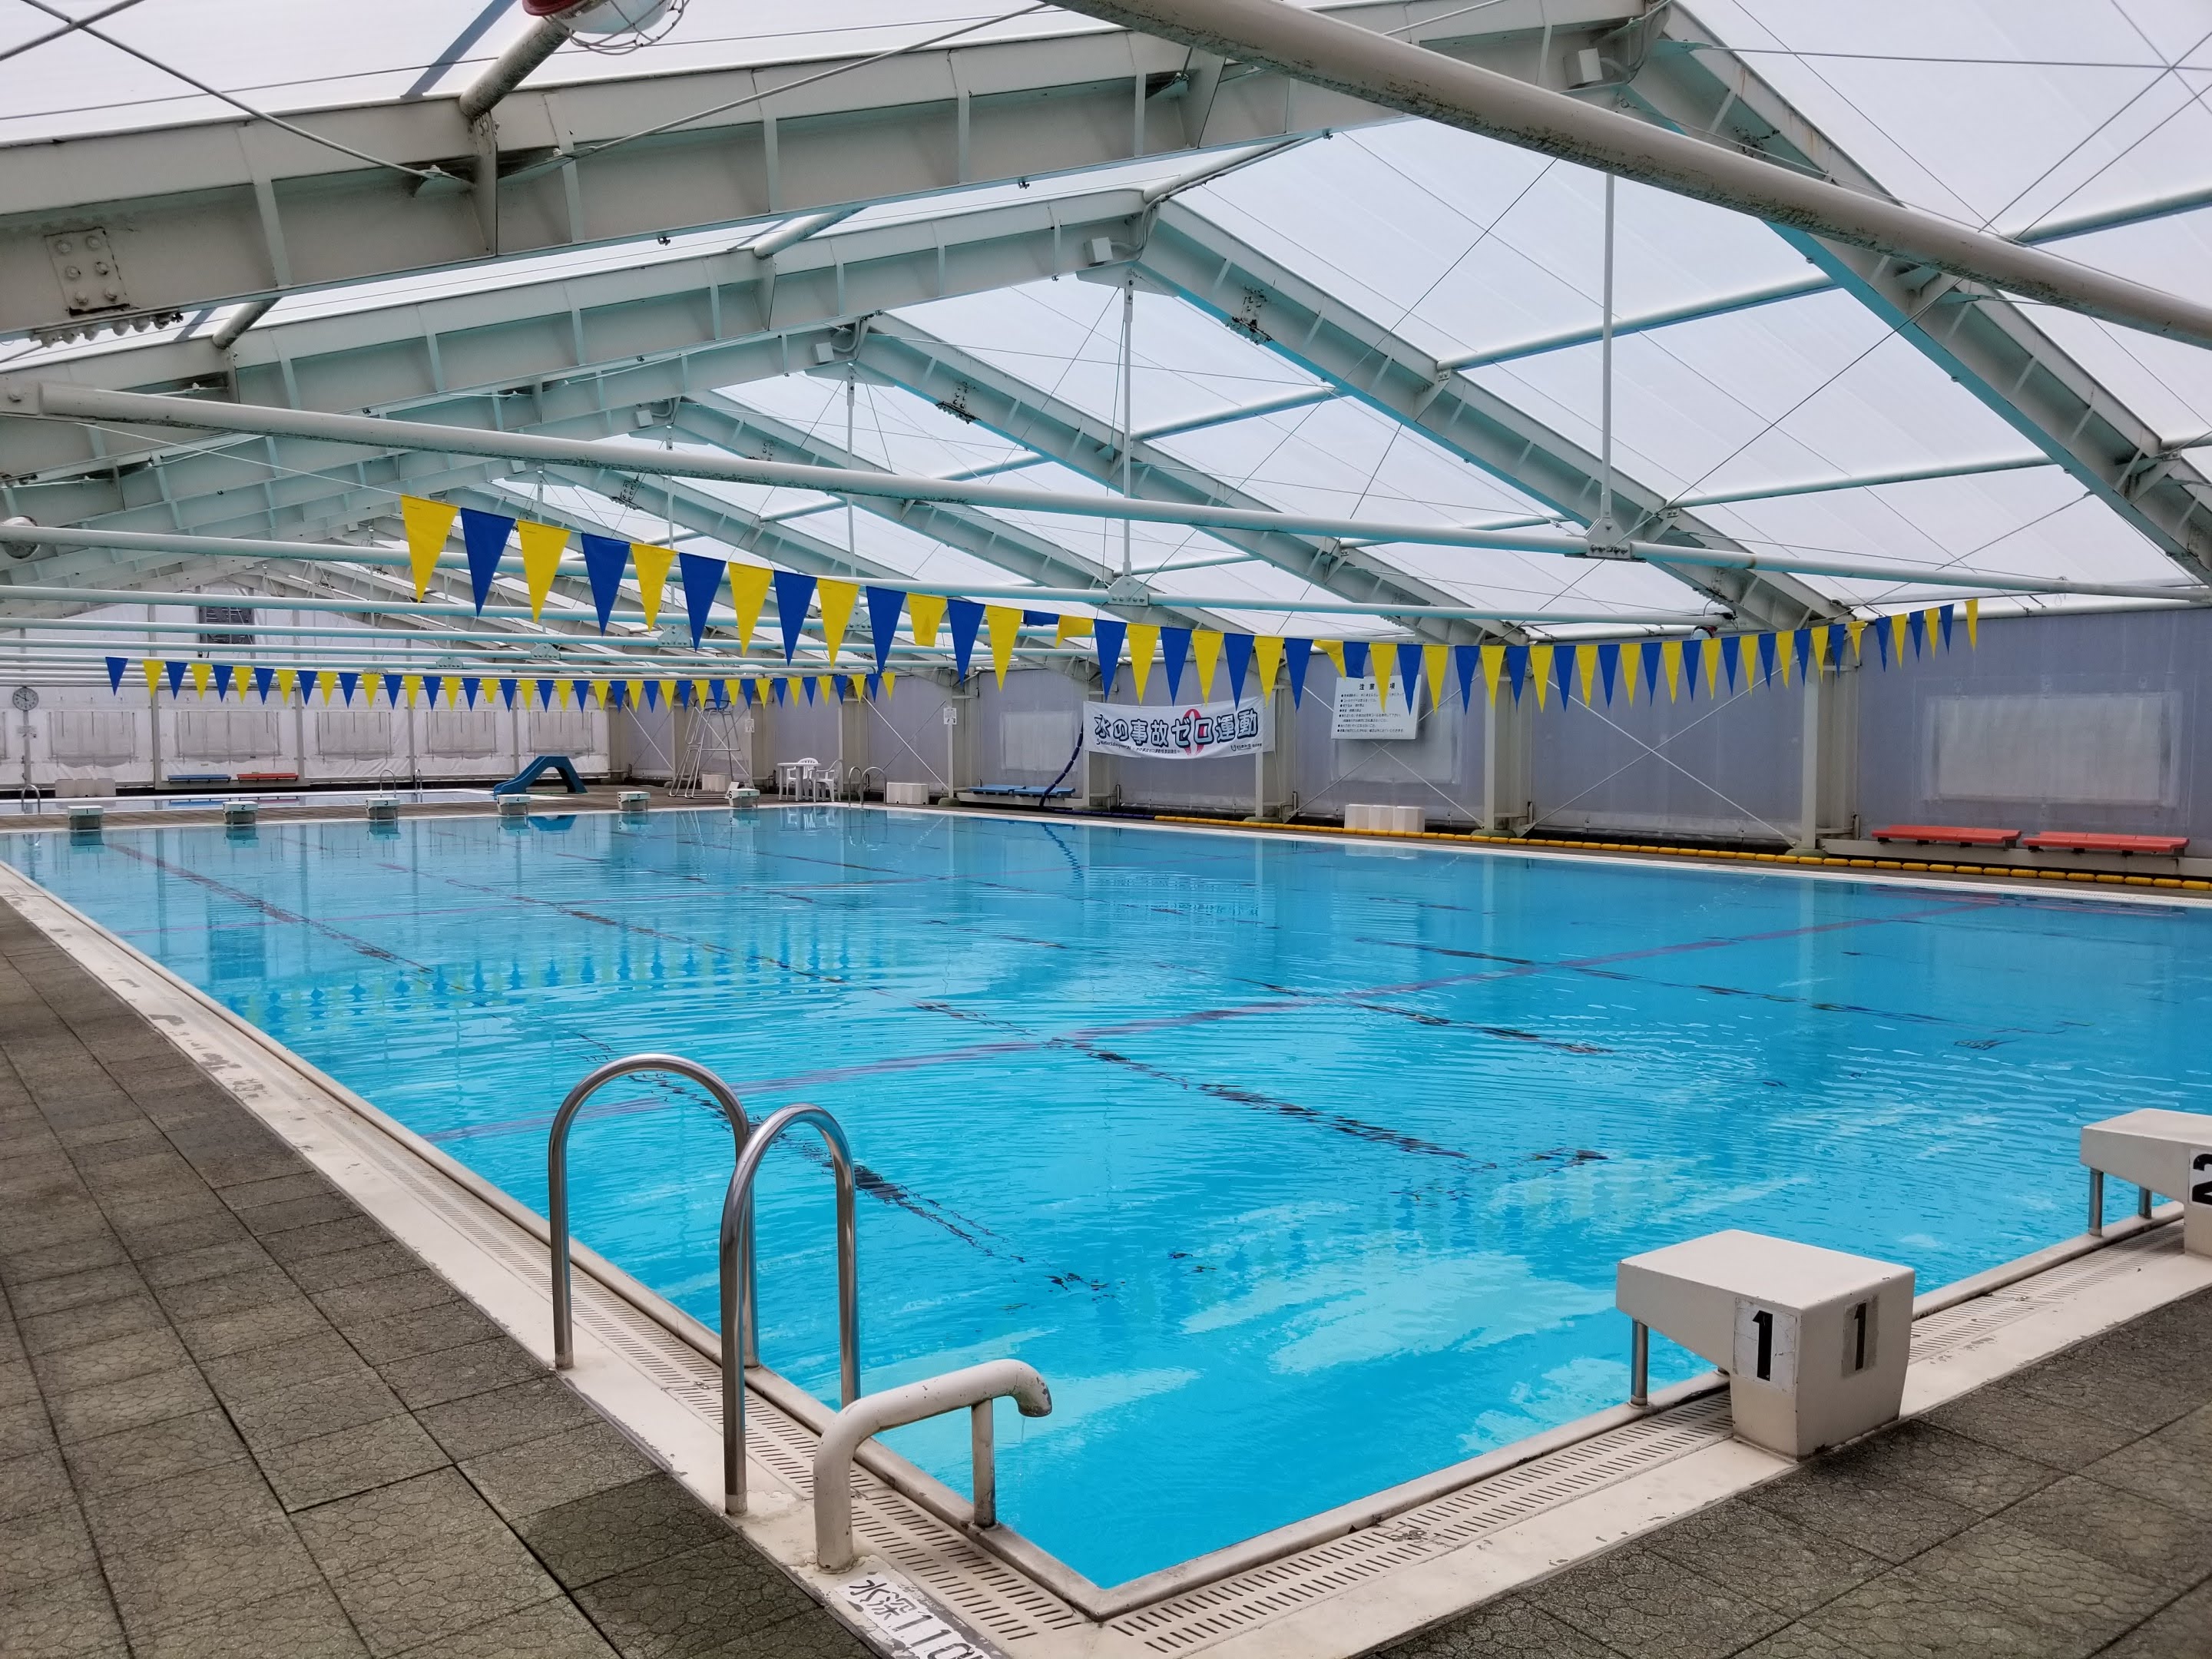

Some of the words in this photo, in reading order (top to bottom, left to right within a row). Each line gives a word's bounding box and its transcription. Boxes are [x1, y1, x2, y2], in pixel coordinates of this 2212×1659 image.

[1094, 707, 1258, 748] 水の事故ゼロ運動
[1752, 1310, 1773, 1381] 1
[1853, 1302, 1867, 1371] 1
